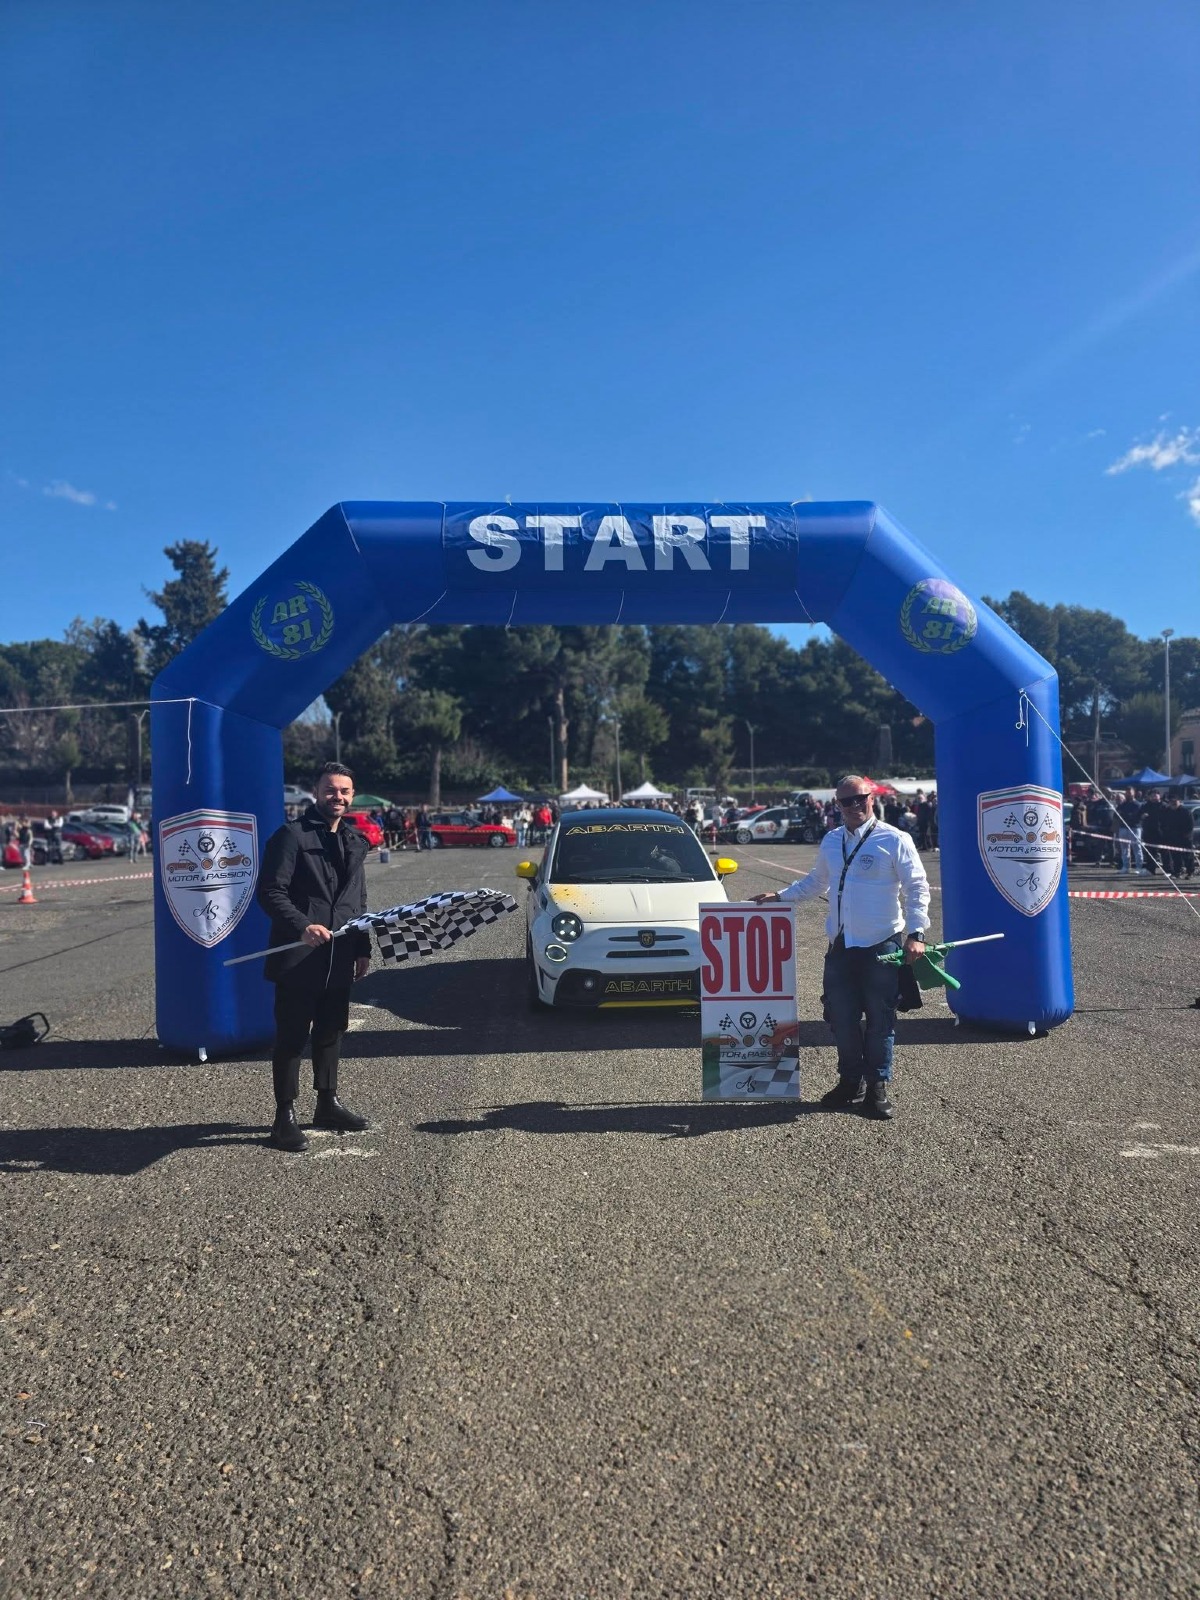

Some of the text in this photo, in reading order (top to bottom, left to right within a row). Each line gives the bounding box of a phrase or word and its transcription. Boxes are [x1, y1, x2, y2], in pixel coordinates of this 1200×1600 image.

[466, 514, 766, 572] START
[270, 594, 309, 625] AR
[920, 596, 958, 617] AR
[282, 619, 313, 645] 81
[922, 620, 955, 640] 81
[565, 823, 685, 836] ABARTH
[987, 845, 1024, 853] MOTOR
[167, 873, 200, 883] MOTOR
[206, 870, 252, 881] PASSION
[701, 915, 793, 994] STOP
[604, 978, 693, 994] ABARTH
